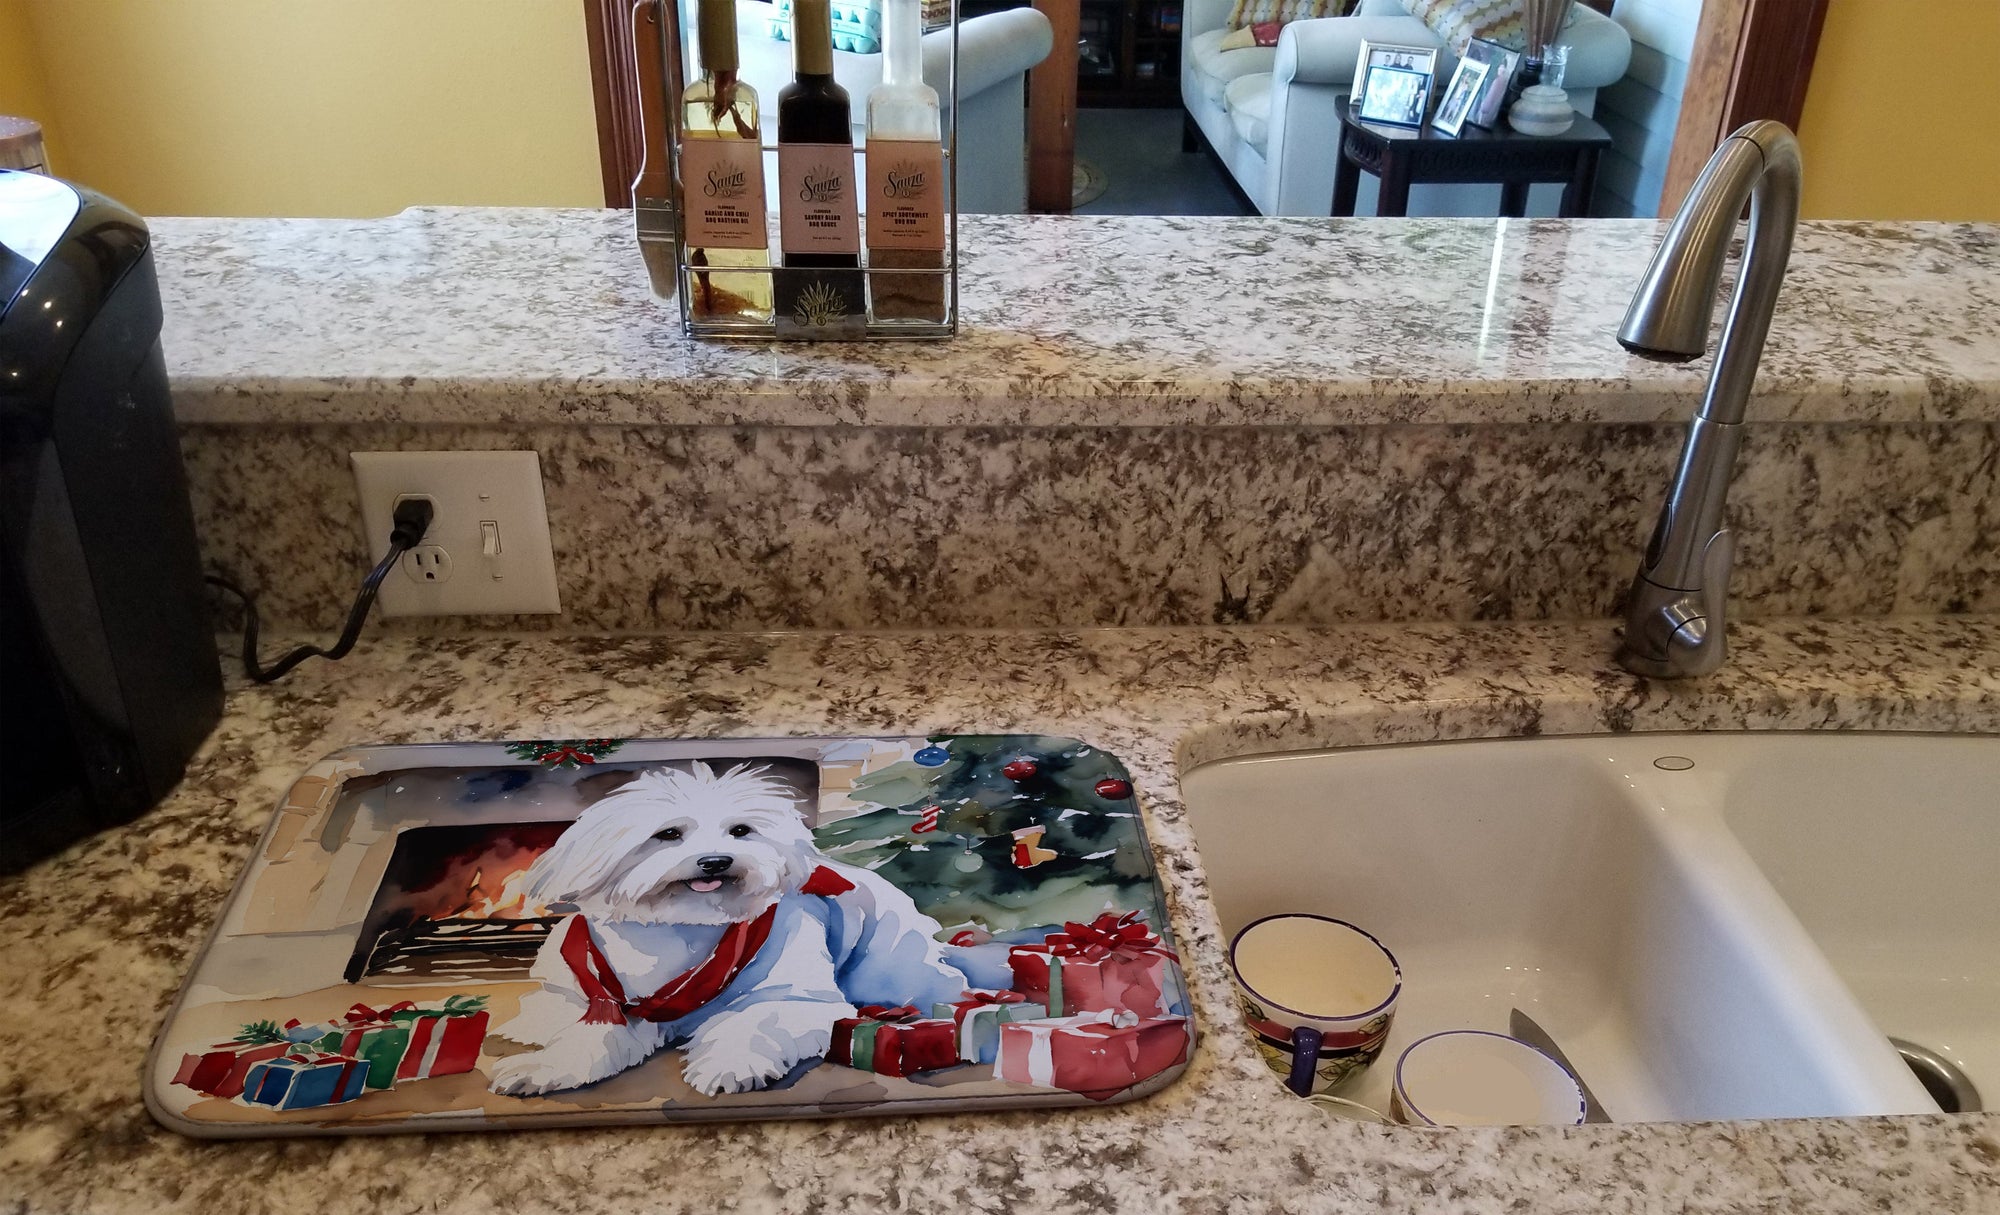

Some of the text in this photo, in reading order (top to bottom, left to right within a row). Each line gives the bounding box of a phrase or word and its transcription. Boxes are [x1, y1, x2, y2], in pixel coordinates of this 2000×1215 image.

[704, 169, 746, 197] Sauza
[800, 175, 842, 202] Sauza
[883, 171, 926, 198] Sauza
[793, 295, 846, 327] Sauza
